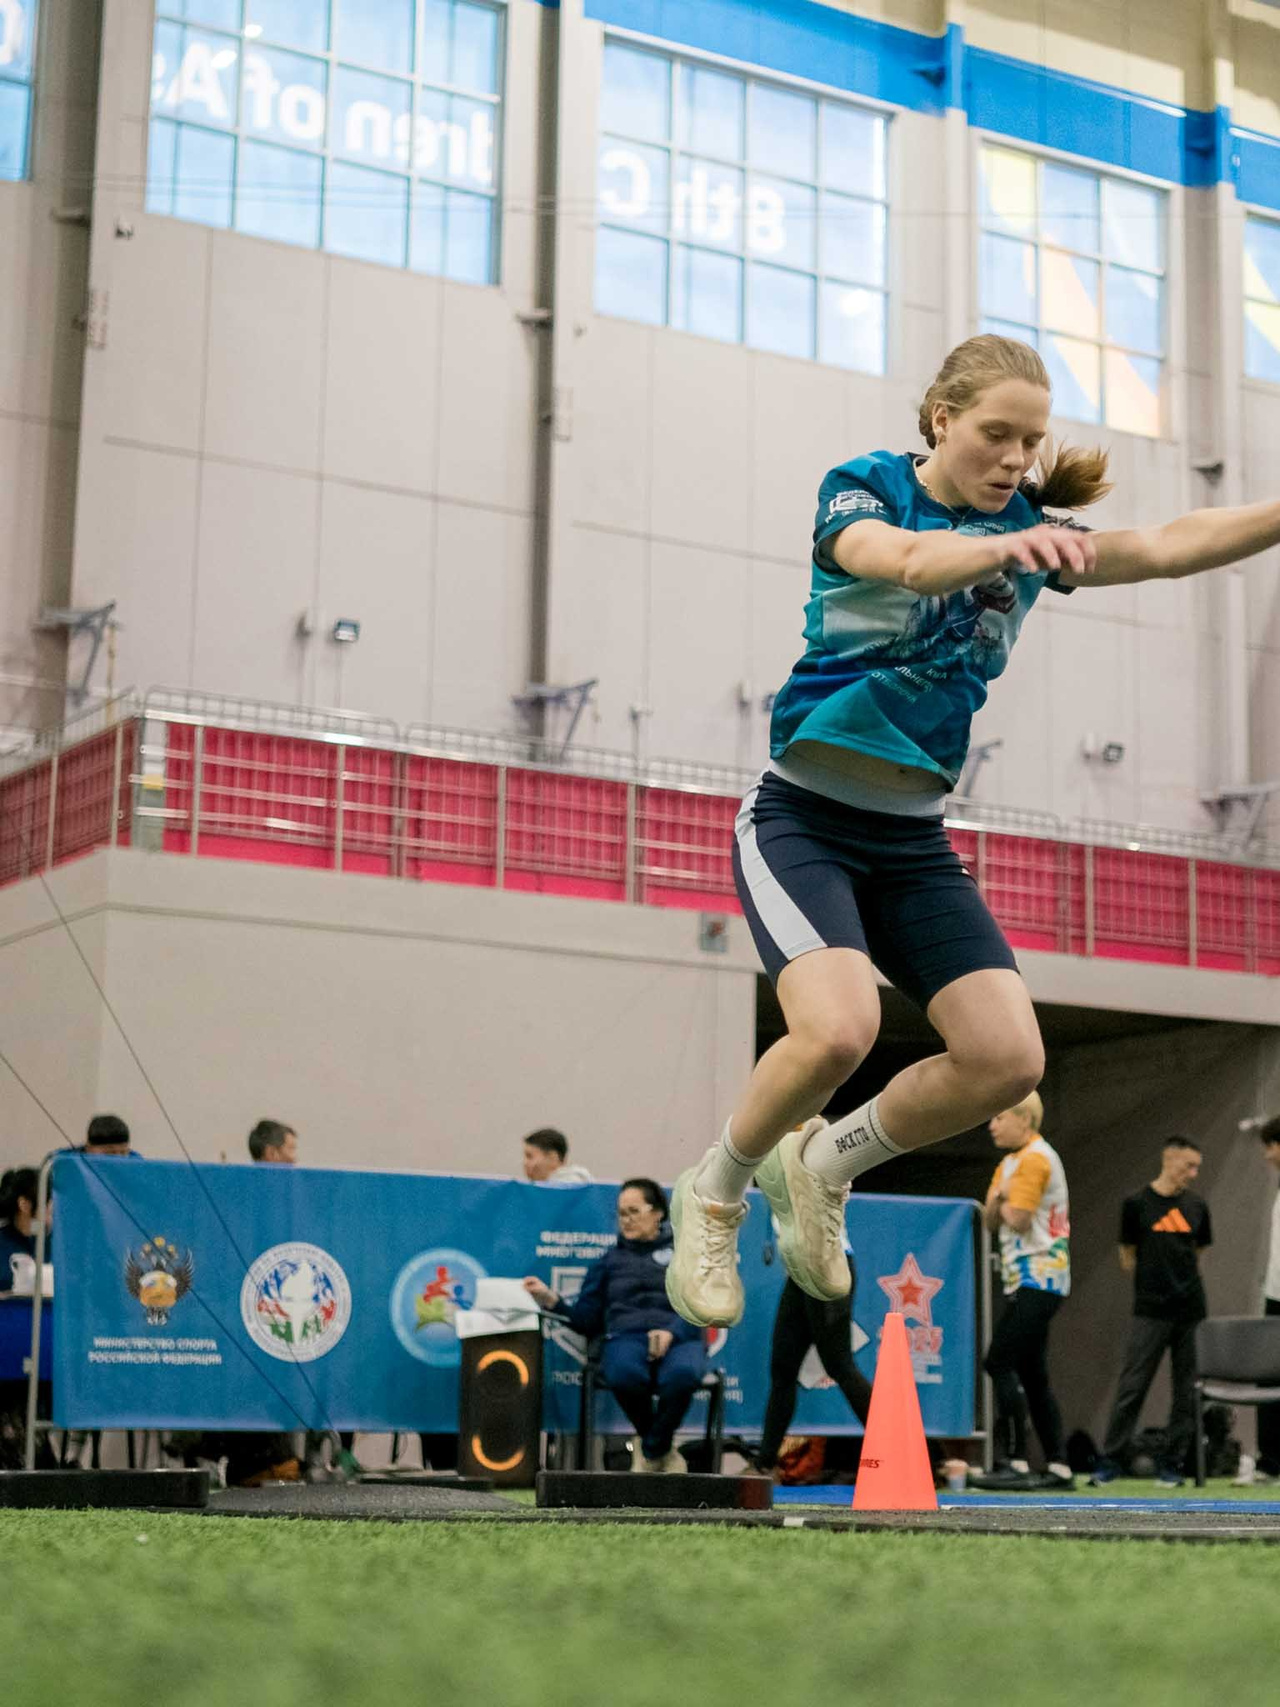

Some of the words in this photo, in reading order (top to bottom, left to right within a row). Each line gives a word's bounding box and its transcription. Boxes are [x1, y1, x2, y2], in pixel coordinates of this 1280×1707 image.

[92, 1337, 175, 1350] МИНИСТЕРСТВО
[176, 1338, 217, 1351] СПОРТА
[88, 1350, 159, 1364] РОССИЙСКОЙ
[162, 1352, 222, 1365] ФЕДЕРАЦИИ
